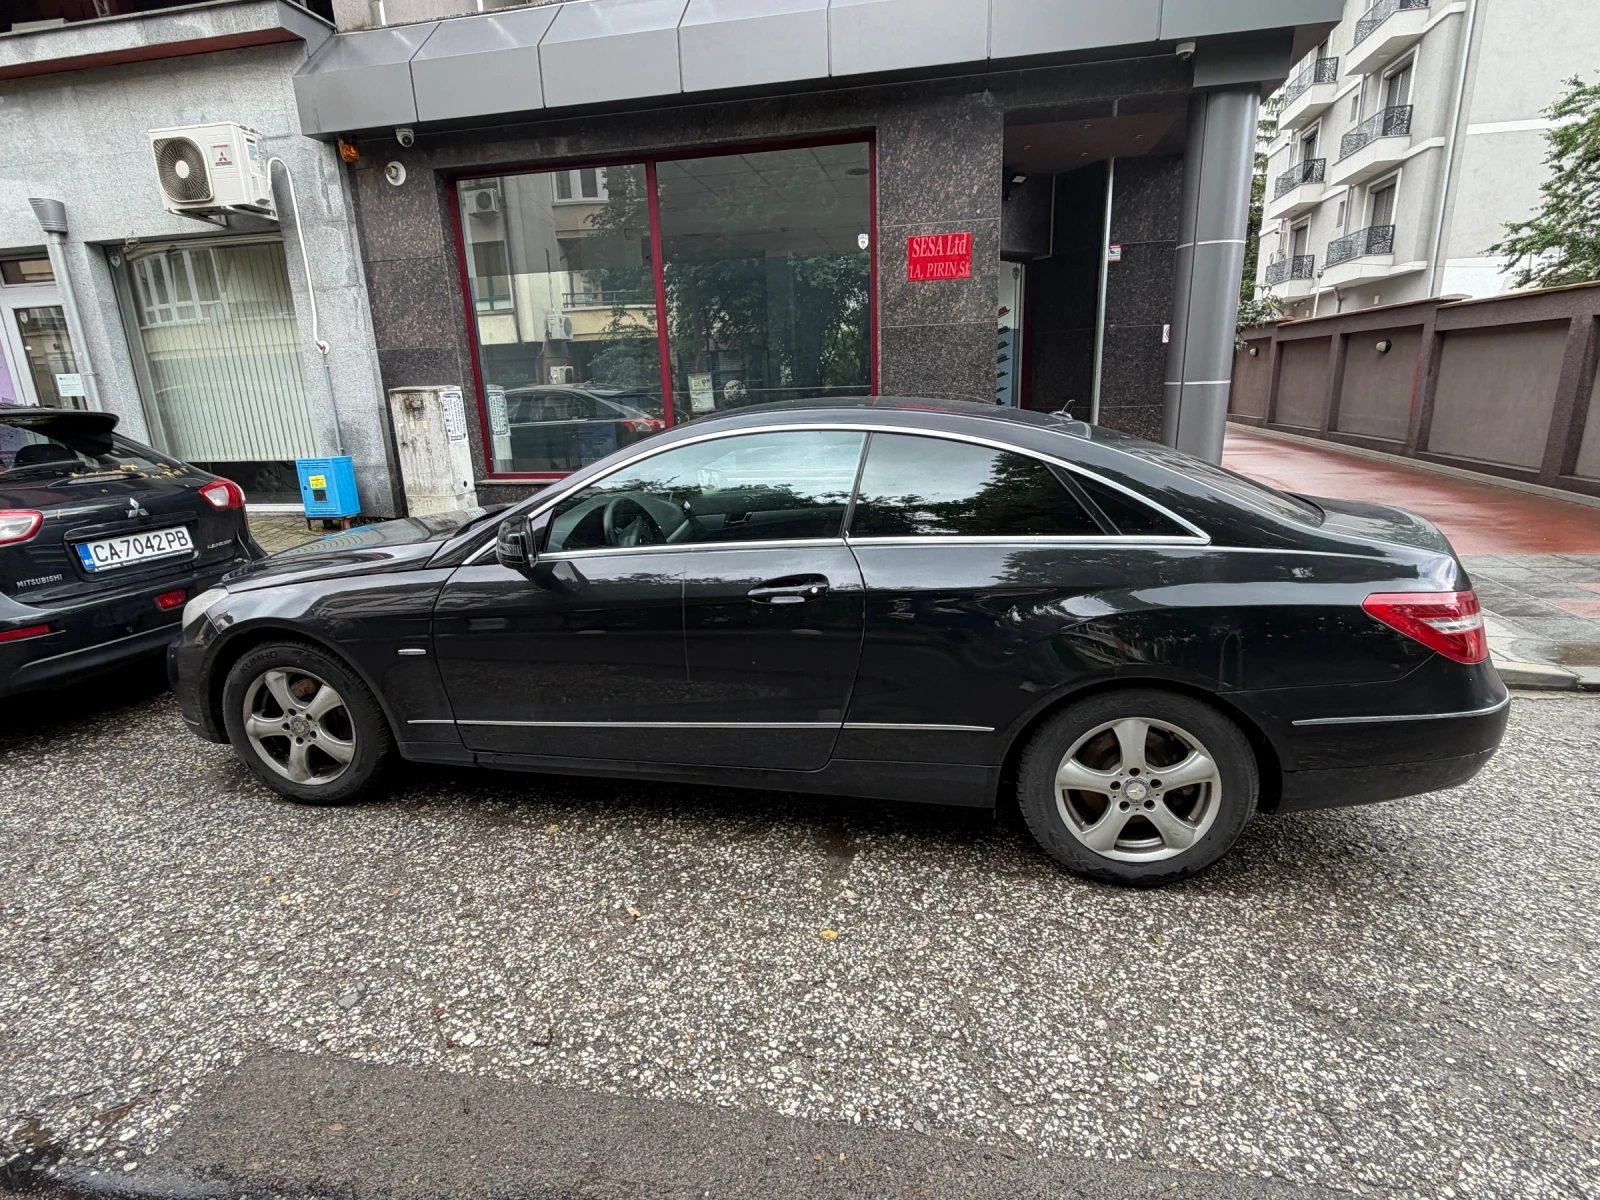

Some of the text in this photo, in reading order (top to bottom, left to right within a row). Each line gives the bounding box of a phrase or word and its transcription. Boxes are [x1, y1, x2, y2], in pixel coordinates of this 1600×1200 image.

[912, 233, 967, 258] SESA Ltd
[909, 263, 924, 280] 1A,
[926, 262, 958, 278] PIRIN
[93, 543, 121, 562] CA
[120, 535, 167, 558] 7042
[165, 530, 189, 549] PB
[84, 558, 95, 566] BG
[16, 573, 63, 588] MITSUBISHI
[239, 650, 278, 675] KUMHO
